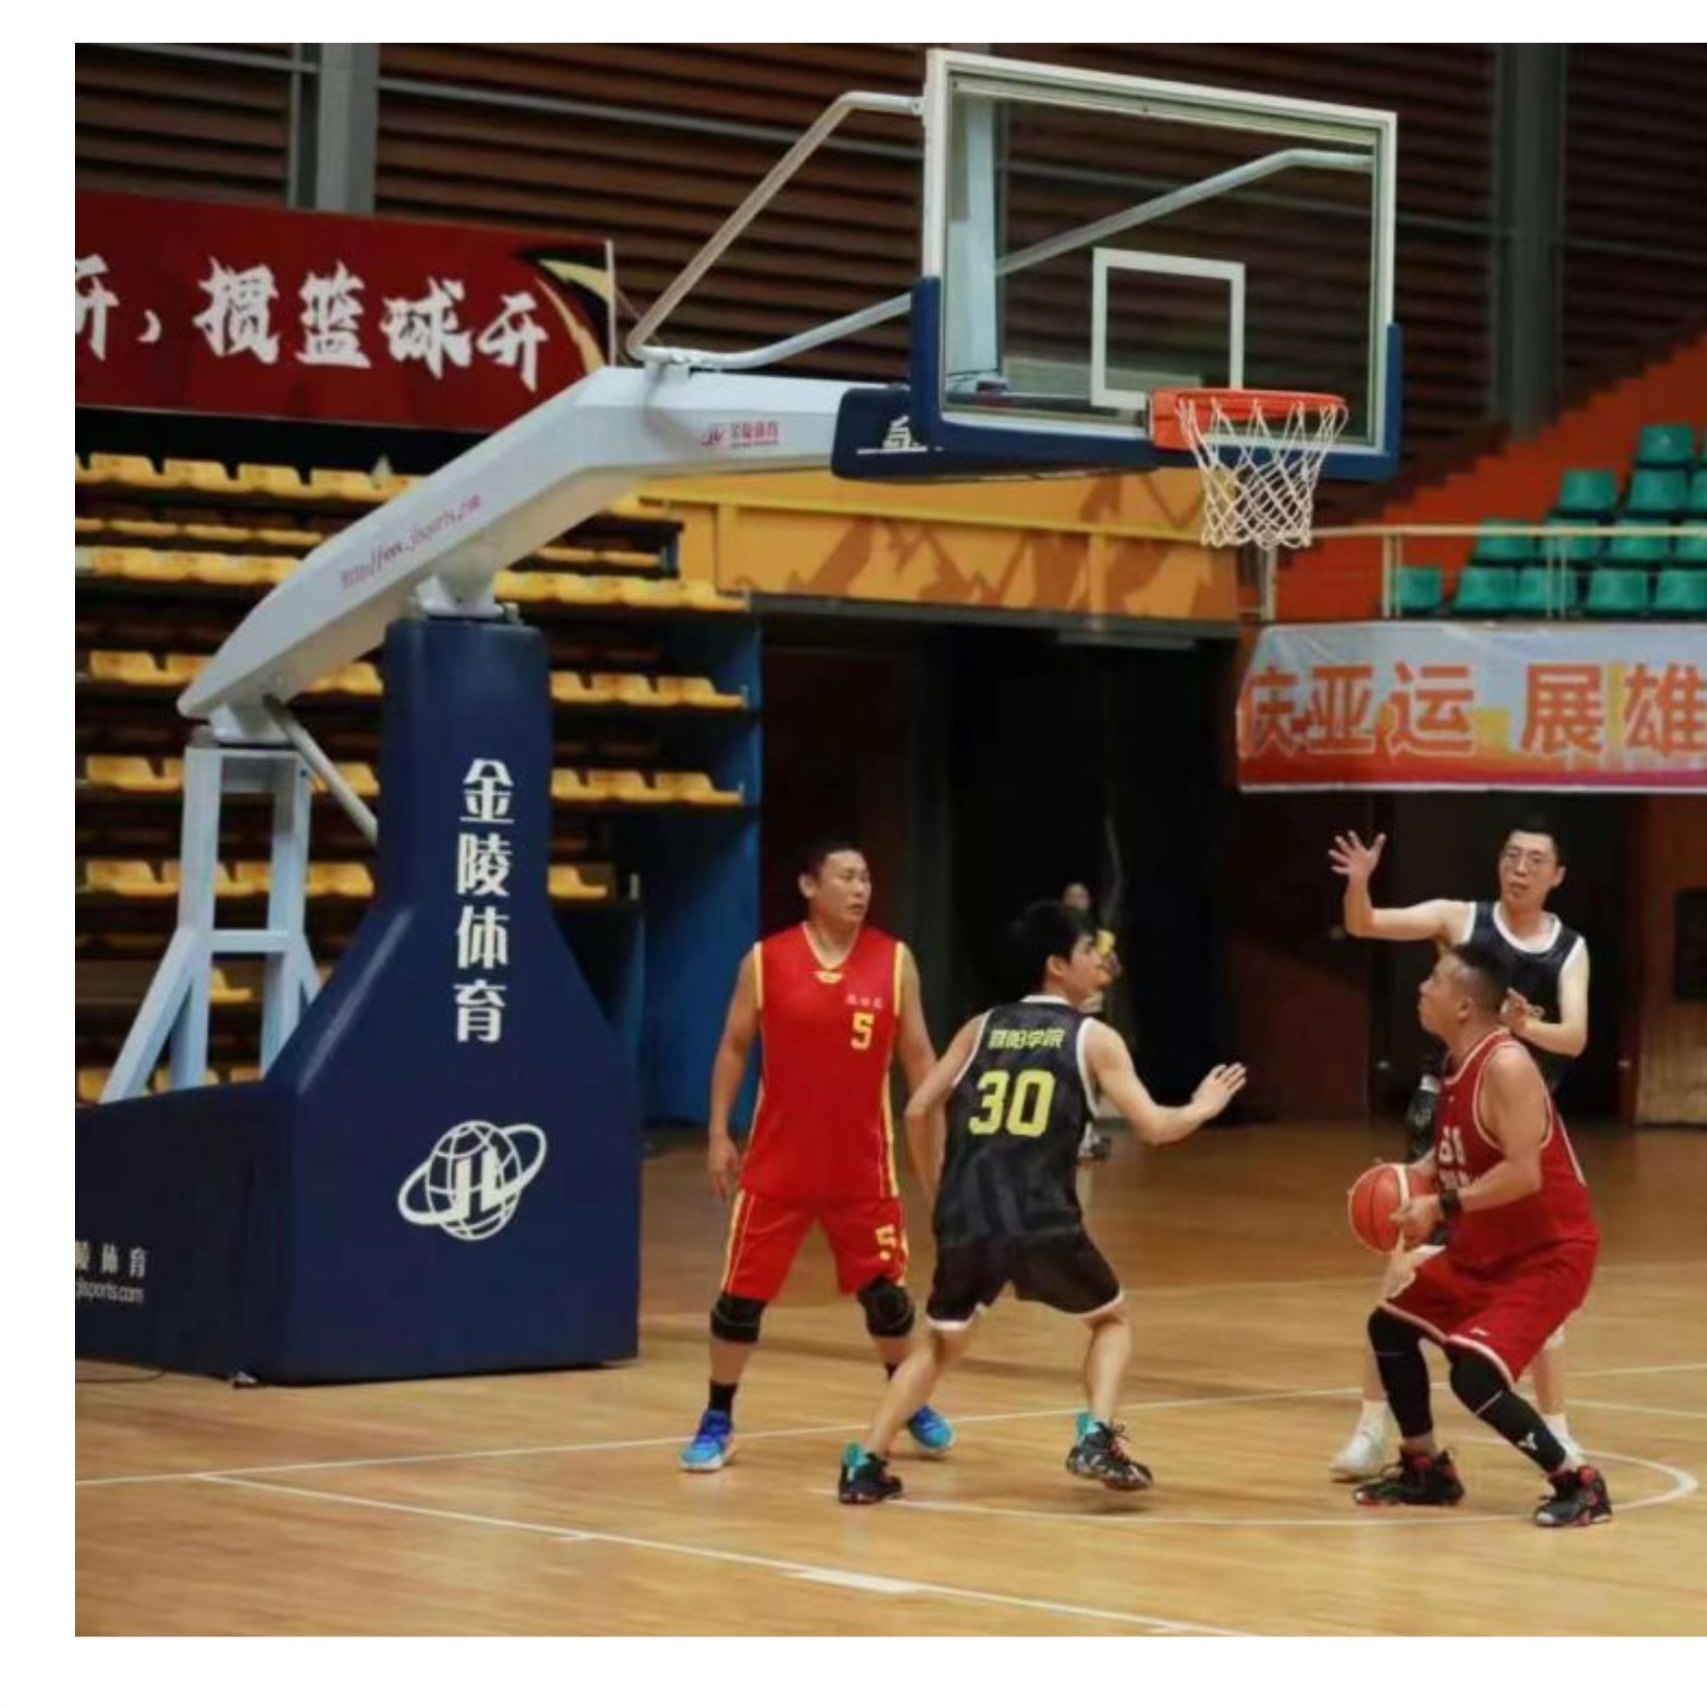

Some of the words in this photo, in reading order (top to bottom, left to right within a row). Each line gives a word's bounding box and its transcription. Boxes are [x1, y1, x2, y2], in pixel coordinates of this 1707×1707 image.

[453, 757, 516, 1044] 金陵体育
[850, 1011, 875, 1051] 5
[968, 1068, 1057, 1138] 30
